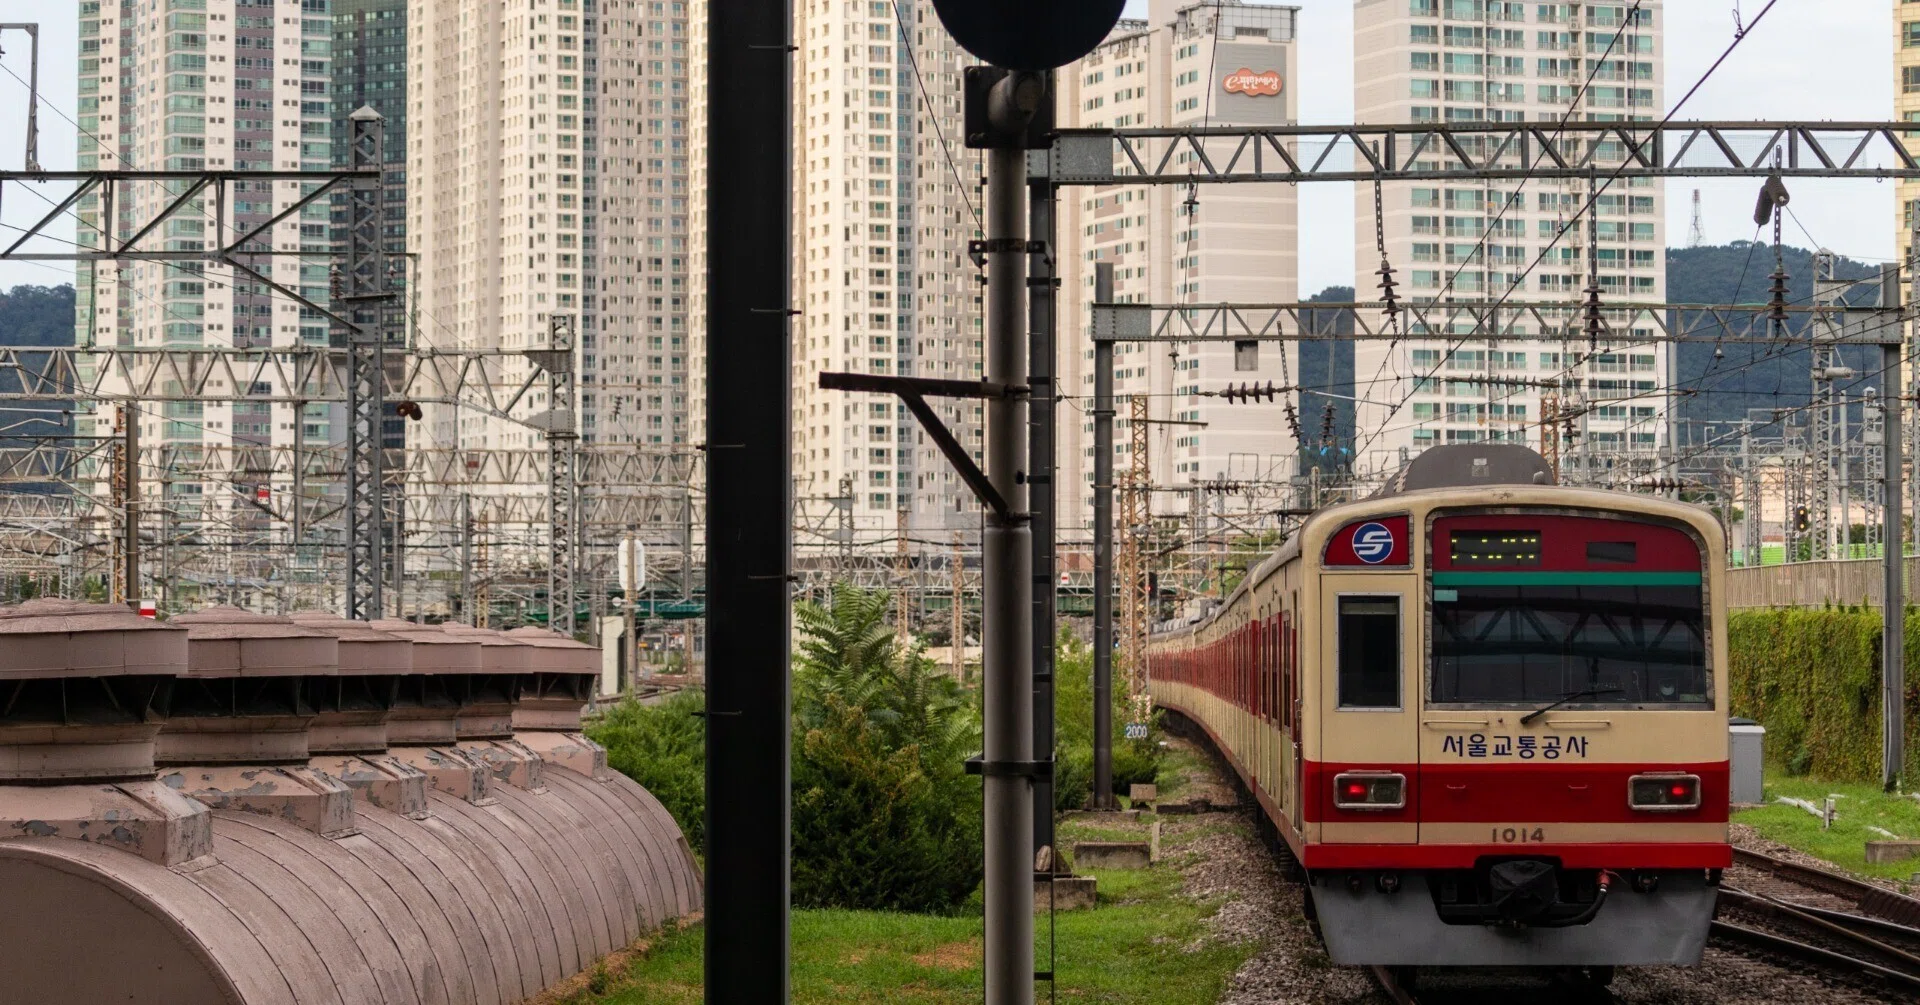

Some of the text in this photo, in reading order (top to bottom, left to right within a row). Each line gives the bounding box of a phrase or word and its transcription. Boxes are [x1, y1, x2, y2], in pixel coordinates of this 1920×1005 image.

[1125, 725, 1148, 739] 2000
[1442, 733, 1589, 760] 서울교통공사
[1491, 827, 1545, 843] 1014
